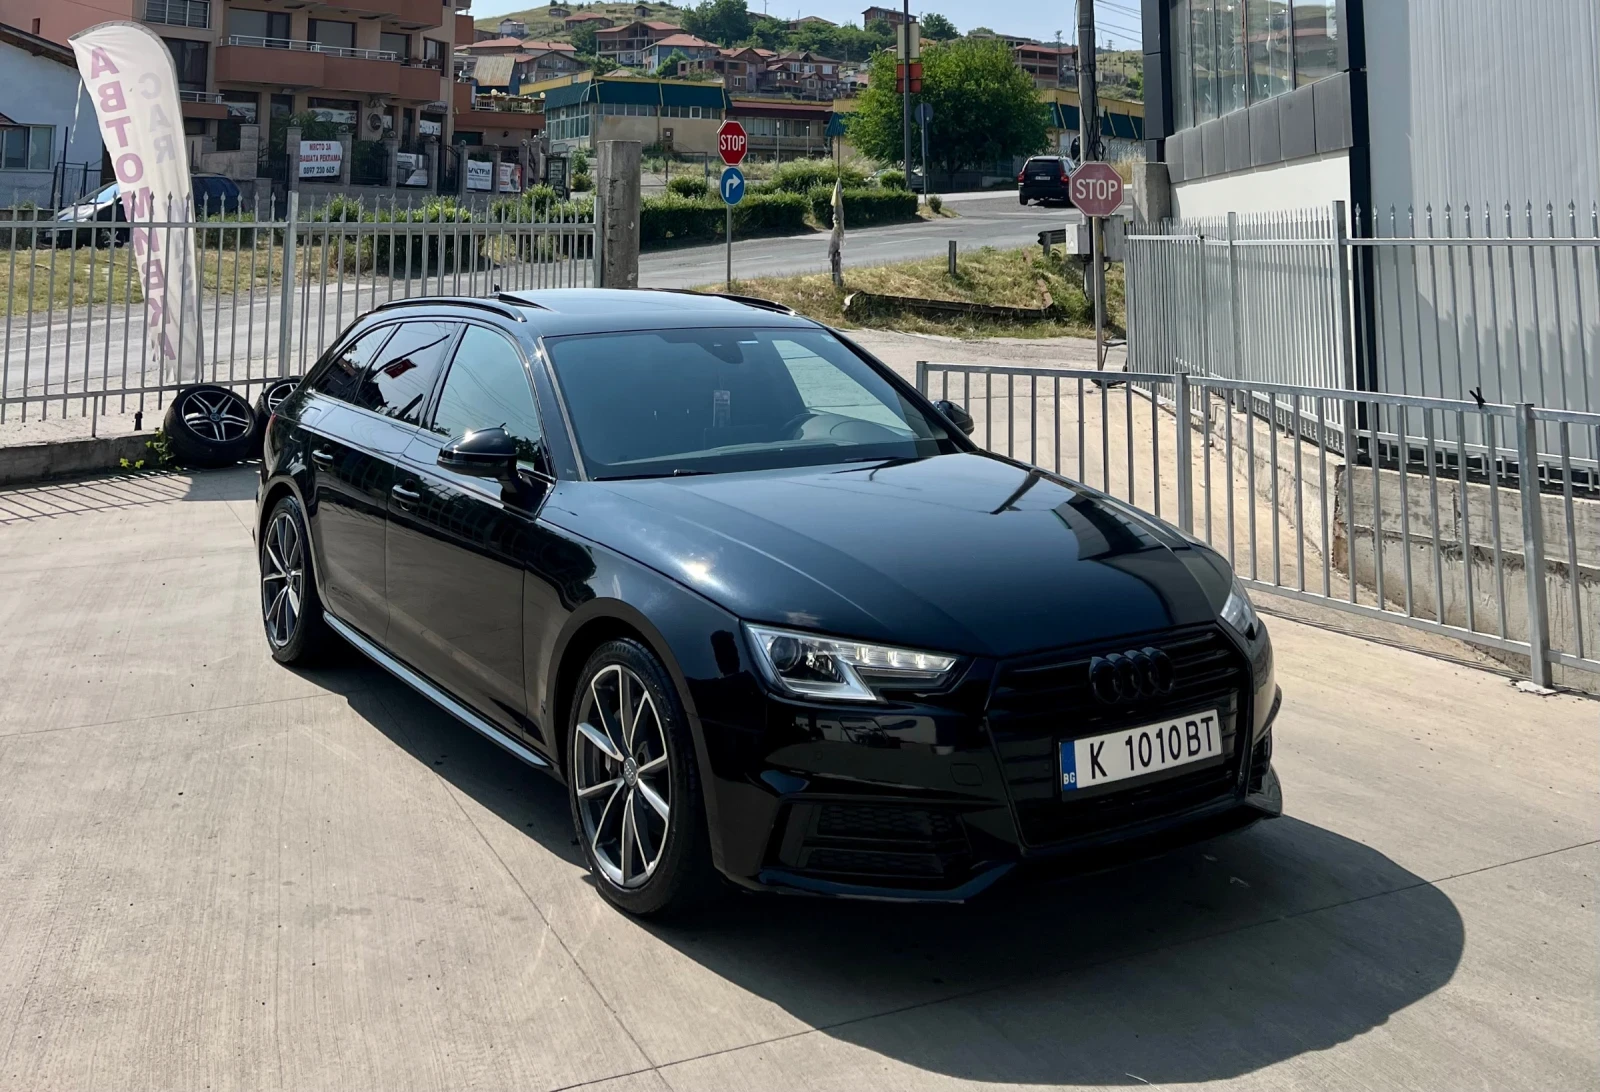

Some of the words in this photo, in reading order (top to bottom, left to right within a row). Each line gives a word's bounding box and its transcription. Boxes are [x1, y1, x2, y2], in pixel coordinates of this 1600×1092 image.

[720, 134, 745, 151] STOP
[1076, 178, 1118, 200] STOP
[1090, 740, 1108, 780] K
[1063, 772, 1076, 785] BG
